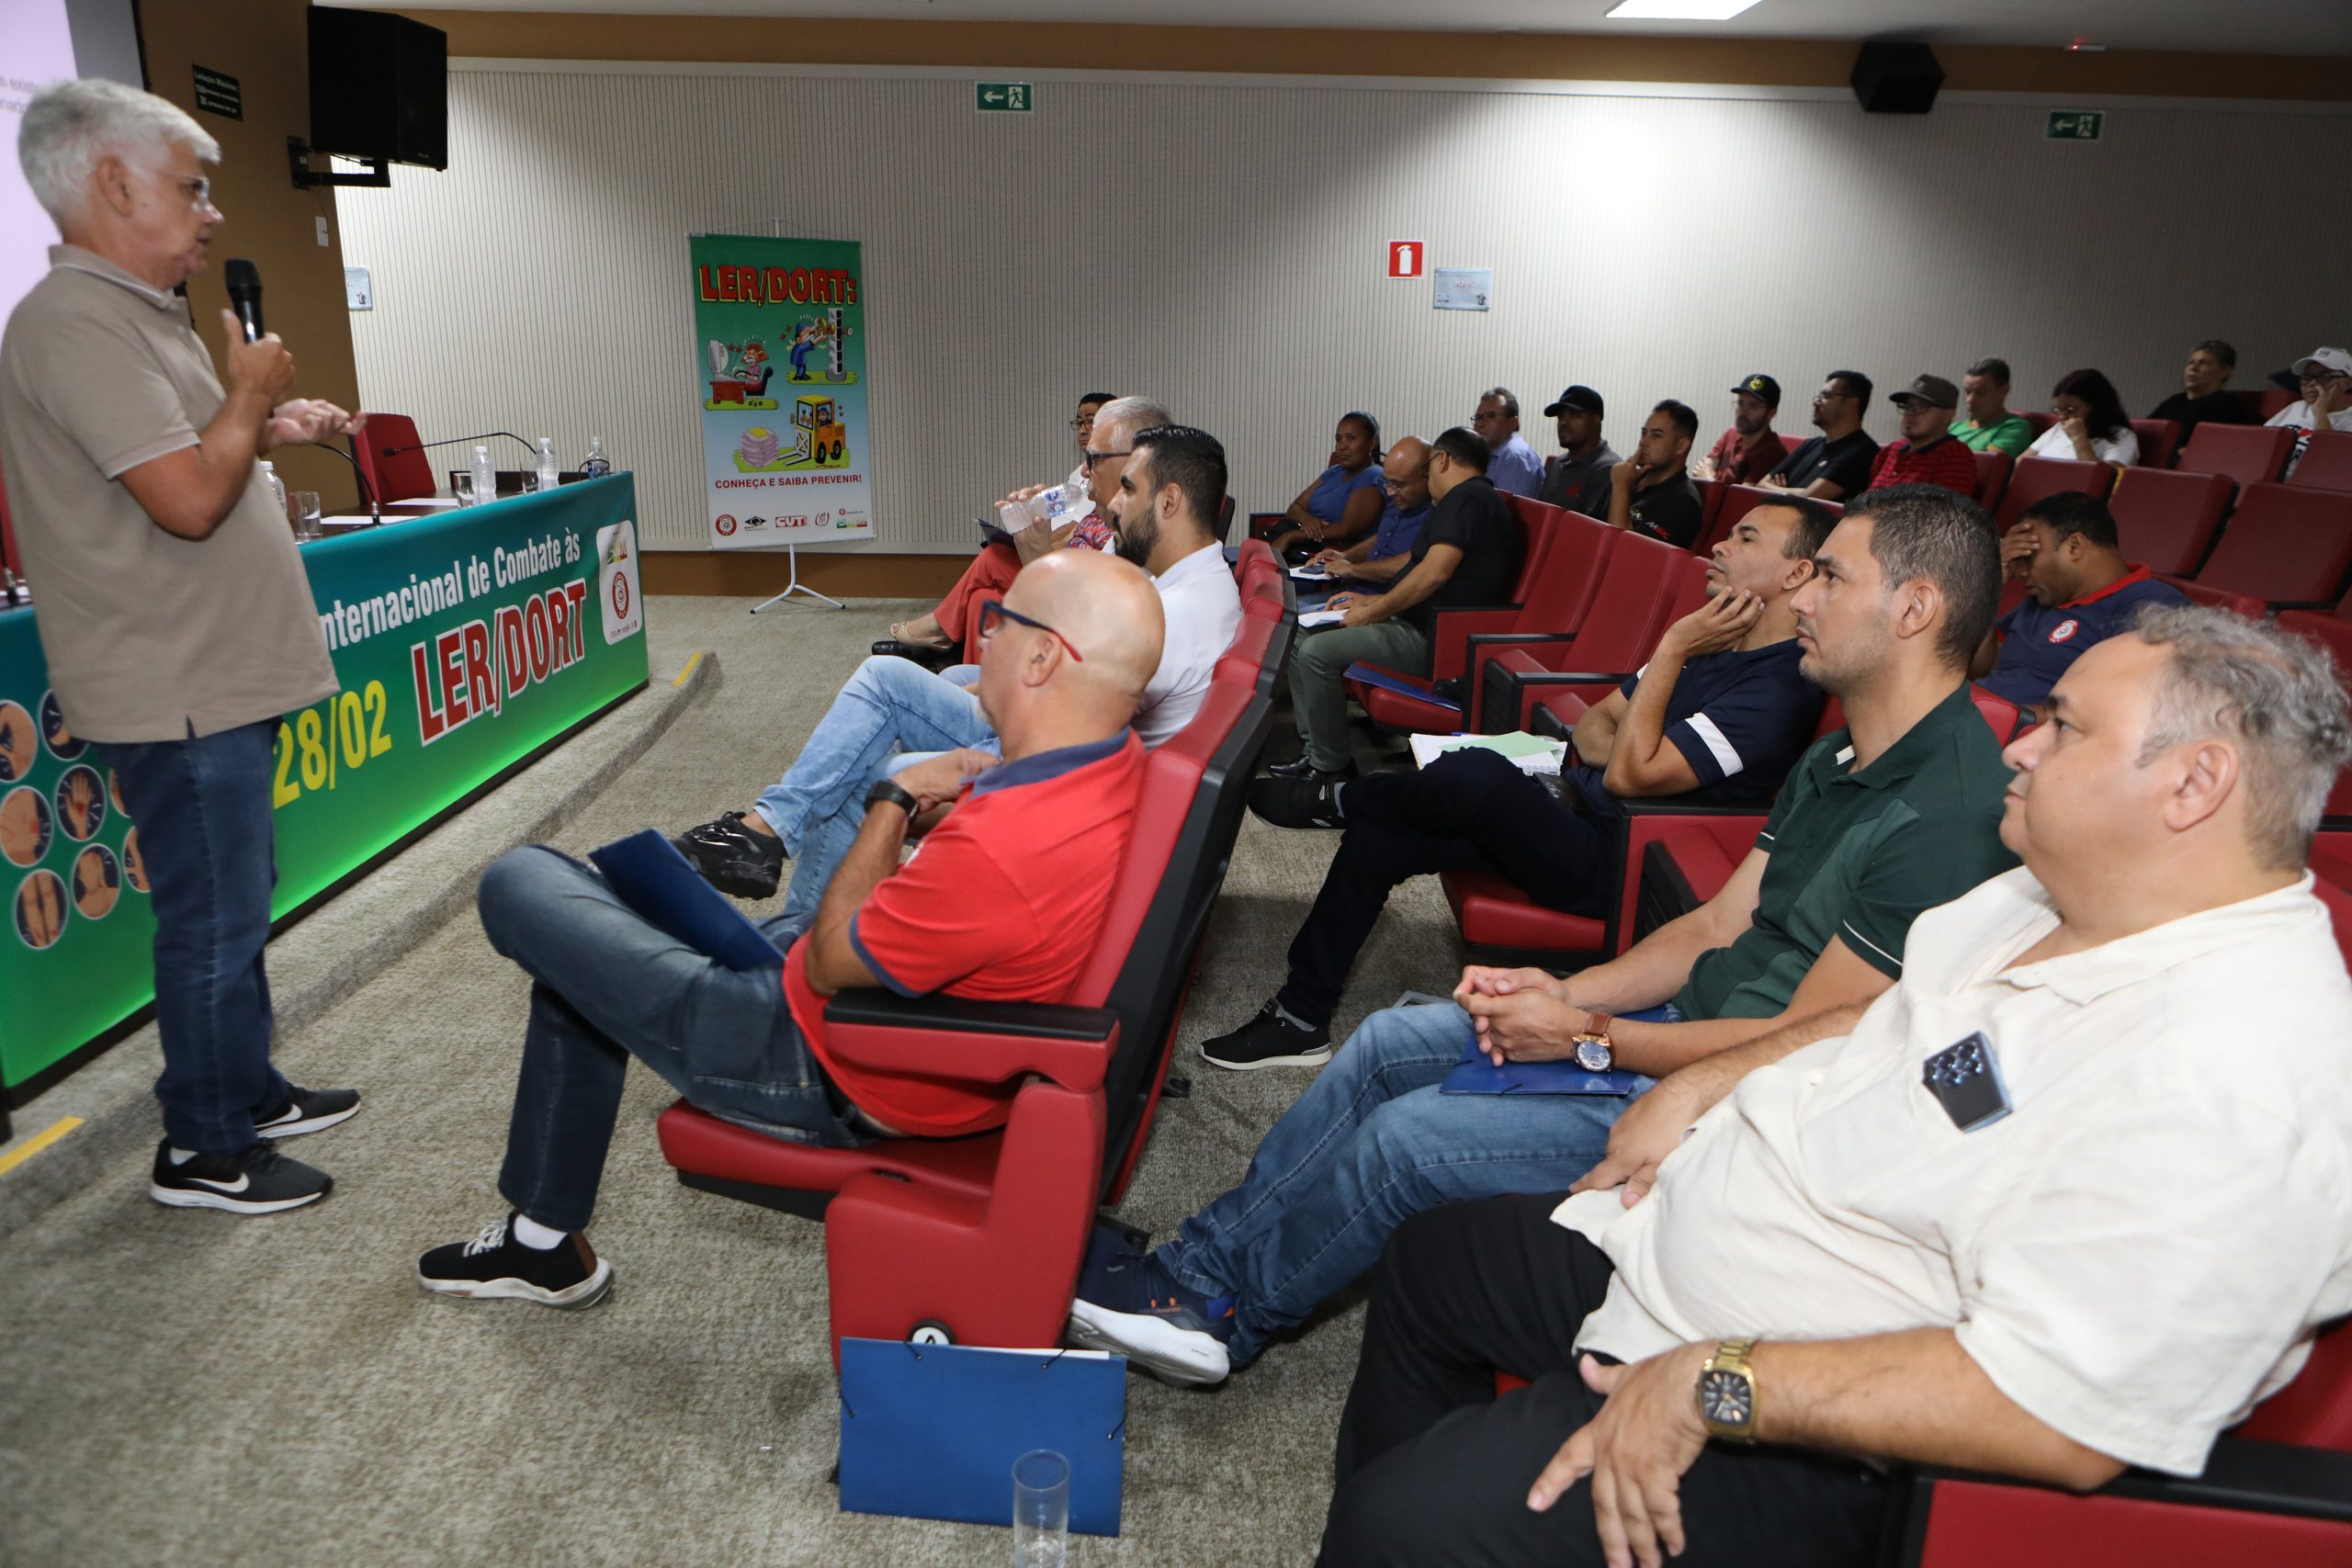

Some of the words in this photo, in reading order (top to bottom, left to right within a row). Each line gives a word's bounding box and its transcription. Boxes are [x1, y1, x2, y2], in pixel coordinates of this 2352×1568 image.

[715, 478, 766, 490] CONHEÇA
[769, 478, 775, 487] E
[778, 476, 808, 486] SAIBA
[811, 474, 862, 484] PREVENIR!
[775, 515, 805, 528] CUT
[319, 559, 463, 651] nternacional
[468, 555, 491, 599] de
[493, 537, 562, 589] Combate
[564, 527, 582, 563] às
[411, 578, 587, 748] LER/DORT
[274, 680, 392, 809] 28/02
